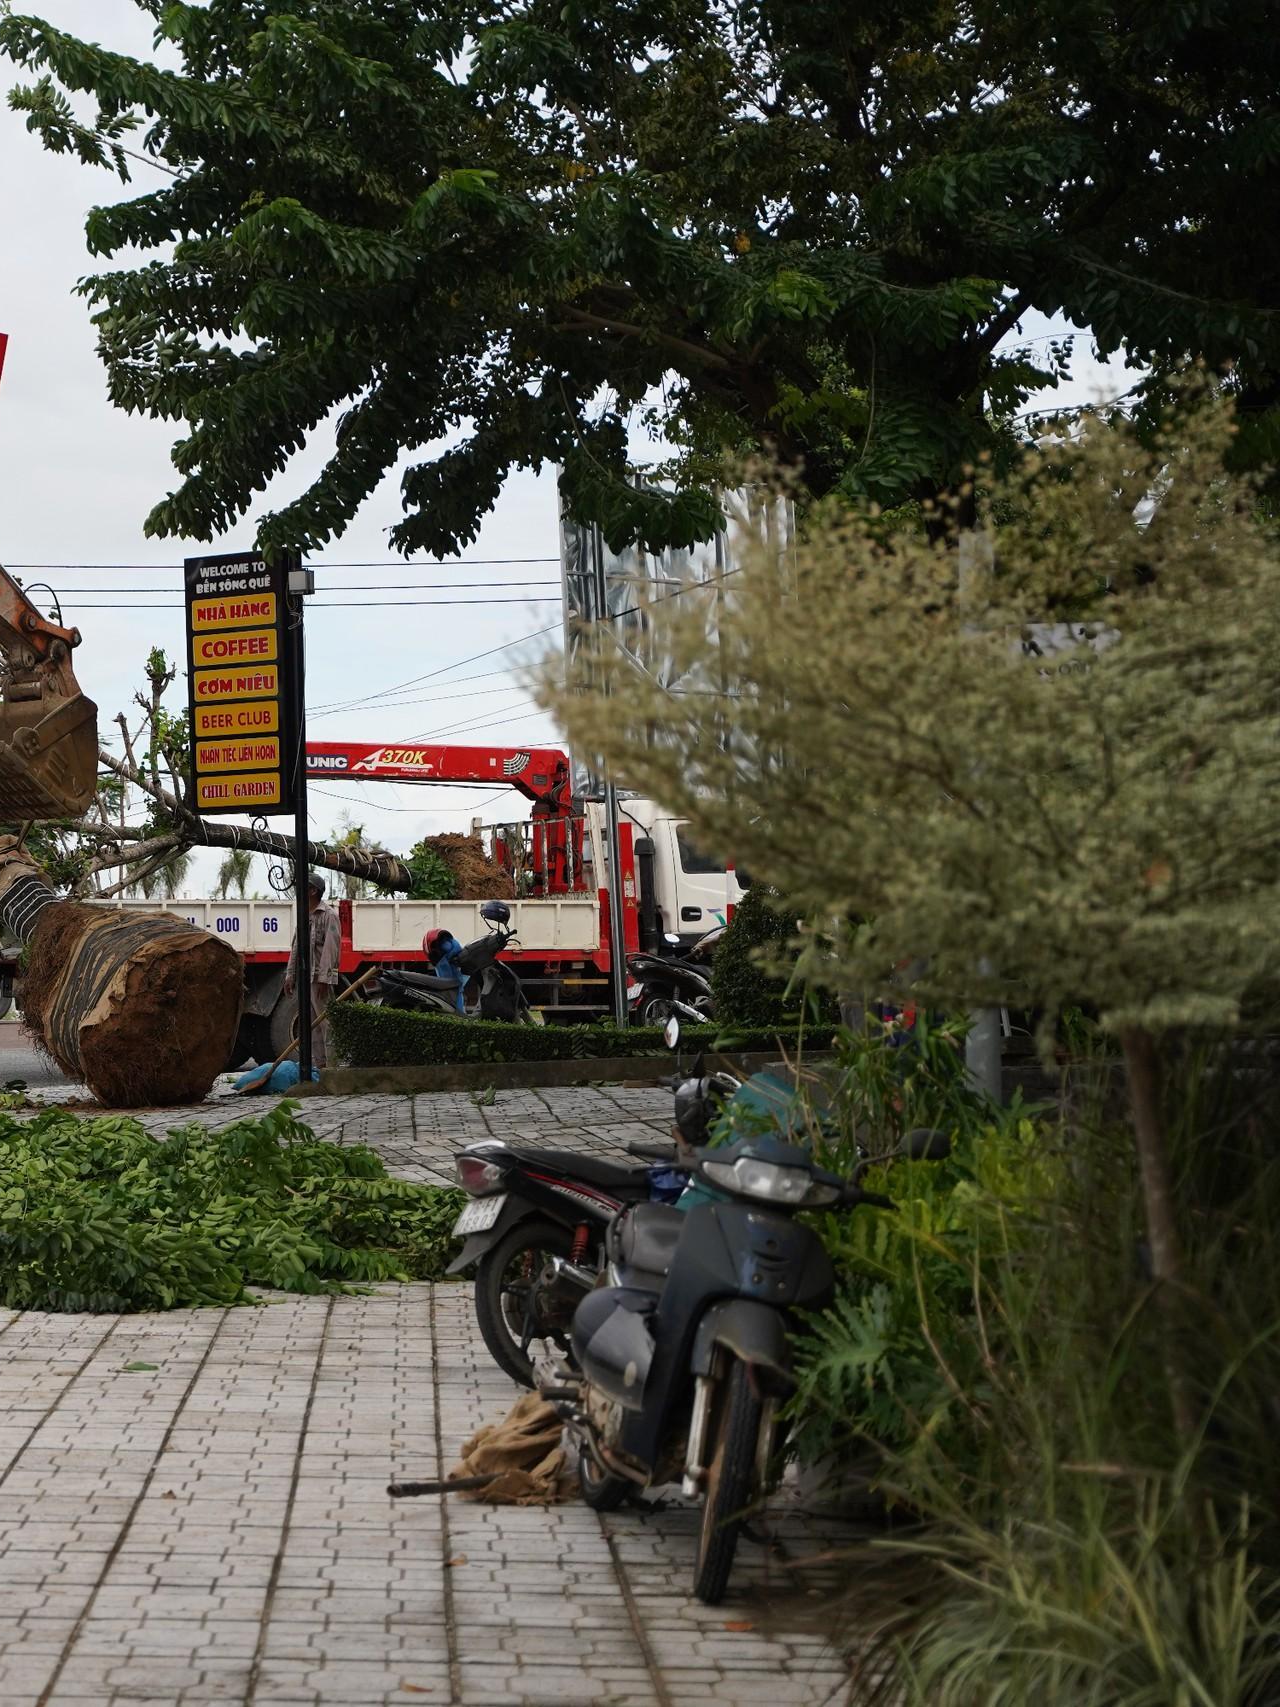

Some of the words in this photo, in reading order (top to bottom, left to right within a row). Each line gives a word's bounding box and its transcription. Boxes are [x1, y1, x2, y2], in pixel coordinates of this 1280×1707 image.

[200, 563, 249, 578] WELCOME
[252, 561, 266, 572] TO
[218, 579, 247, 592] SÔNG
[248, 574, 271, 590] QUÊ
[197, 602, 226, 622] NHÀ
[230, 600, 270, 619] HÀNG
[201, 637, 268, 658] COFFEE
[198, 678, 232, 695] CƠM
[236, 673, 274, 692] NIÊU
[202, 713, 233, 729] BEER
[237, 711, 271, 726] CLUB
[255, 744, 276, 760] HOAN
[306, 757, 348, 769] UNIC
[202, 784, 230, 798] CHILL
[233, 781, 275, 797] GARDEN
[216, 917, 240, 932] 000
[263, 917, 278, 932] 66
